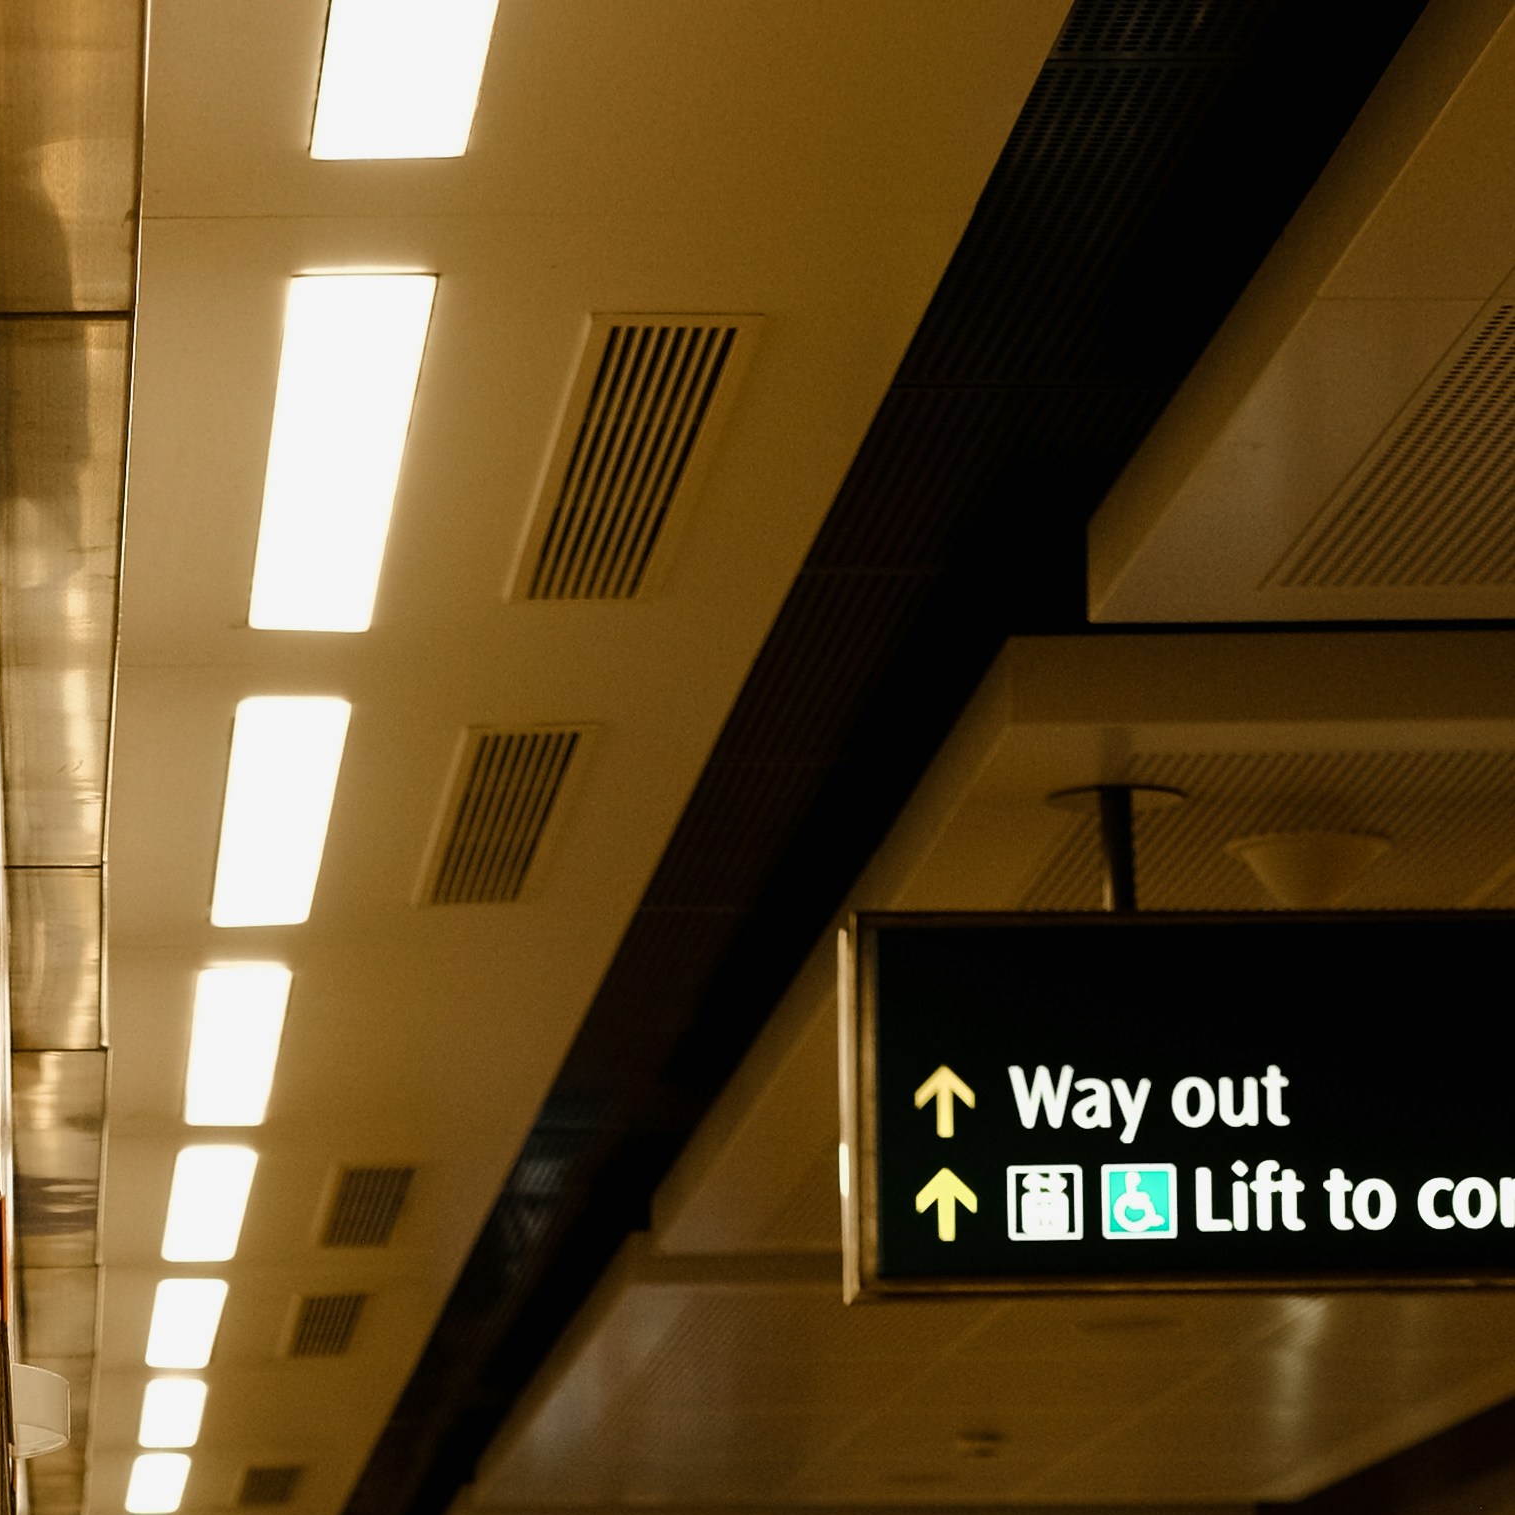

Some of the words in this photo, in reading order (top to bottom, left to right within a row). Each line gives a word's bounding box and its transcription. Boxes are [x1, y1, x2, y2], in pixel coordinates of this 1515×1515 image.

[1008, 1065, 1152, 1144] Way
[1171, 1065, 1291, 1128] out
[1194, 1159, 1306, 1232] Lift
[1323, 1167, 1397, 1231] to
